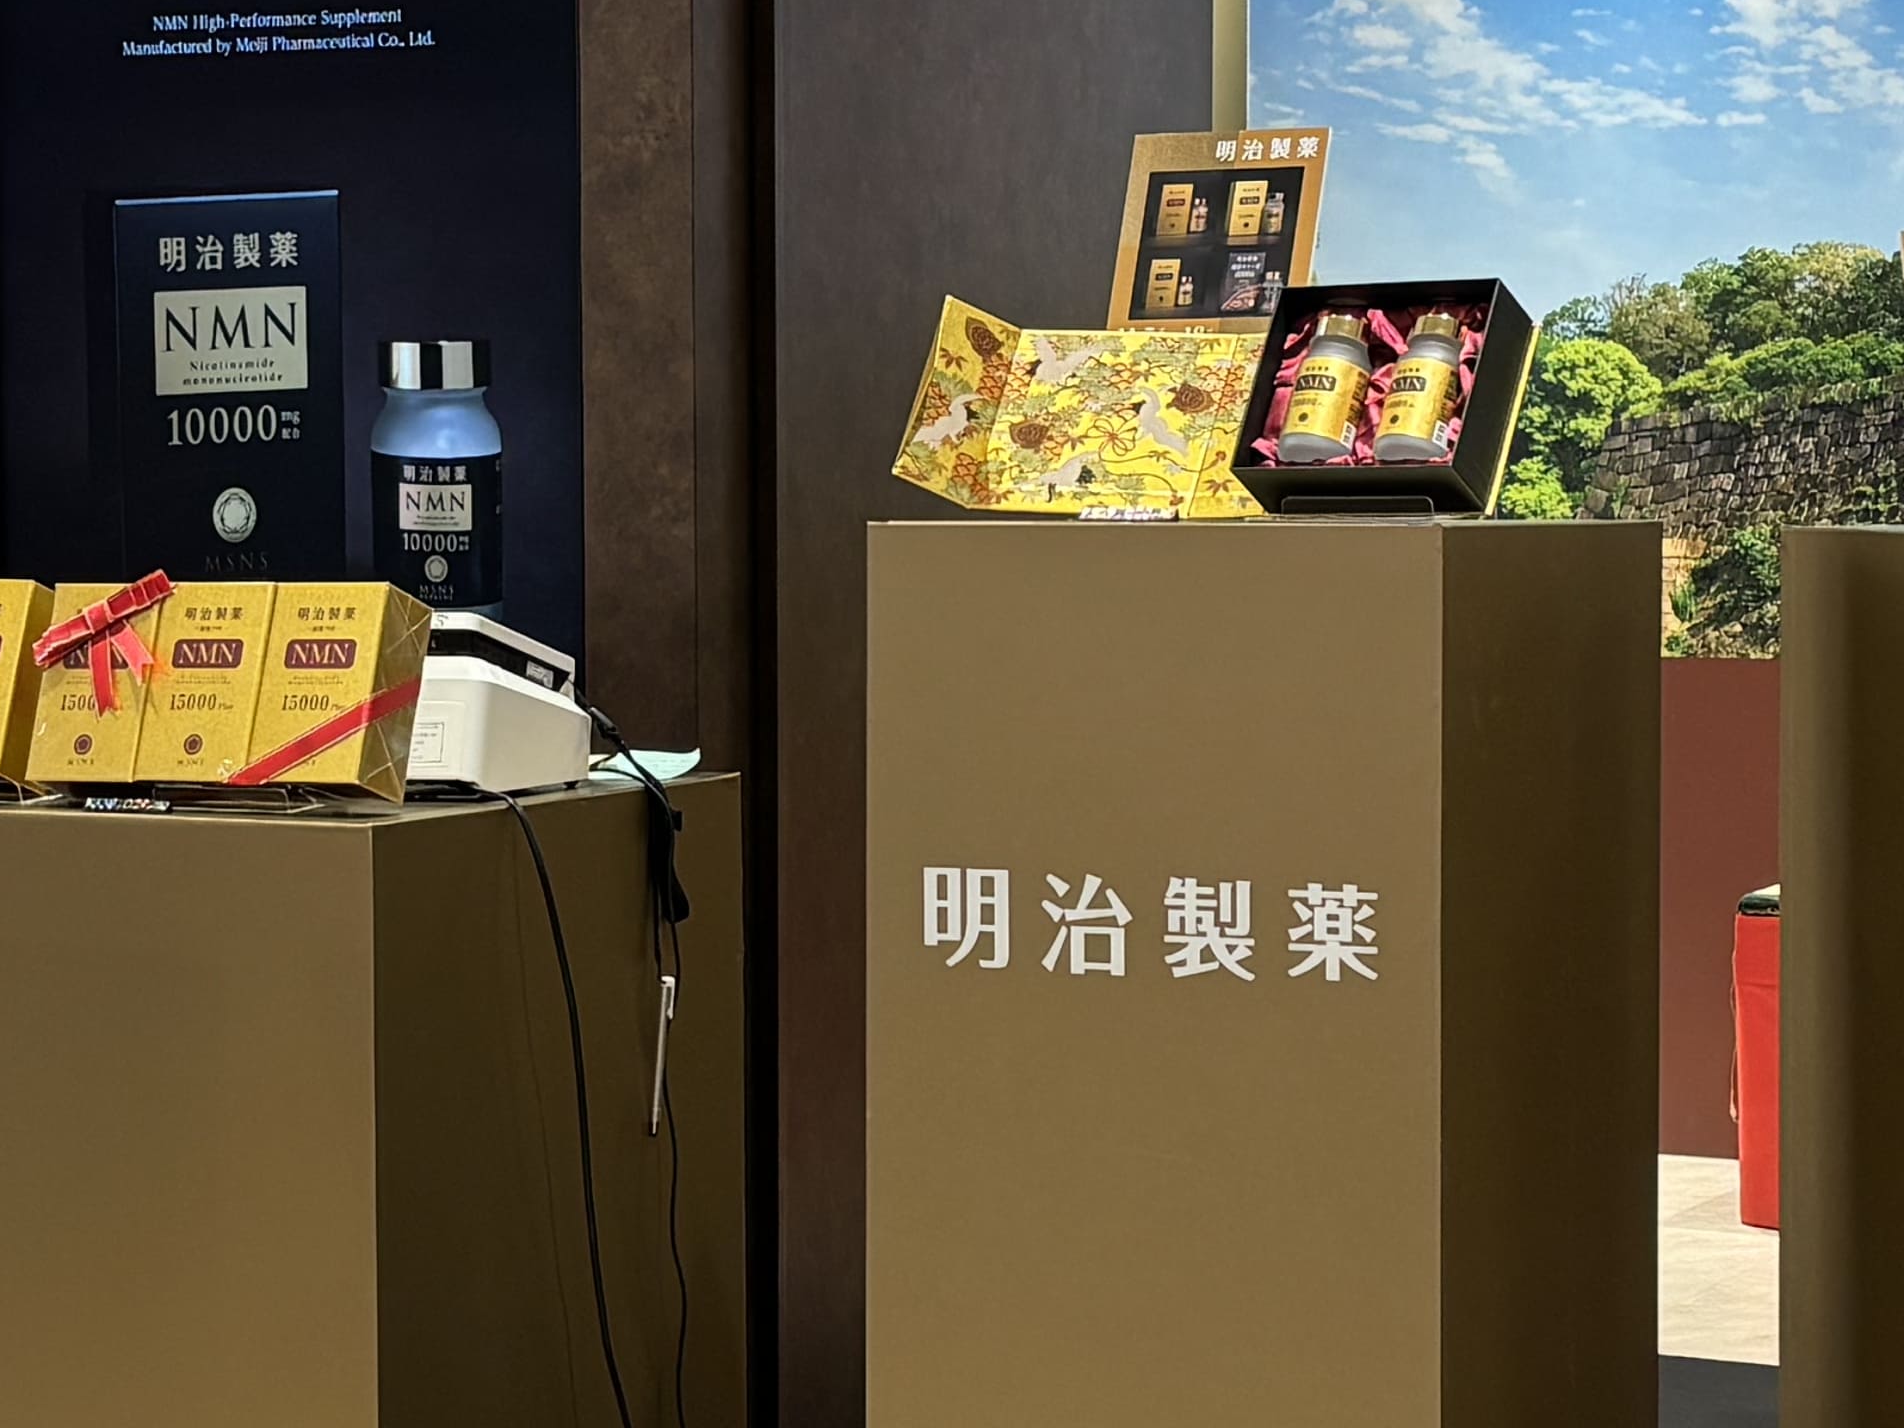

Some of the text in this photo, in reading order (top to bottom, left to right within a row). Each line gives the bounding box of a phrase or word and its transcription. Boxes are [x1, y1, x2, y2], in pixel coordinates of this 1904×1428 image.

[153, 15, 188, 31] NMN
[321, 8, 402, 29] Supplement
[123, 38, 212, 57] Manufactured
[216, 37, 231, 56] by
[236, 34, 268, 54] Meiji
[272, 31, 374, 52] Pharmaceutical
[409, 30, 436, 47] Ltd.
[1216, 137, 1319, 162] 明治製薬
[159, 232, 299, 272] 明治製薬
[161, 302, 298, 354] NMN
[168, 404, 276, 446] 10000
[406, 492, 465, 512] NMN
[403, 532, 457, 552] 10000
[184, 606, 243, 621] 明治製薬
[298, 606, 357, 621] 明治製薬
[178, 643, 236, 664] NMN
[291, 643, 349, 664] NMN
[169, 693, 217, 710] 15000
[282, 695, 329, 711] 15000
[923, 866, 1380, 983] 明治製薬
